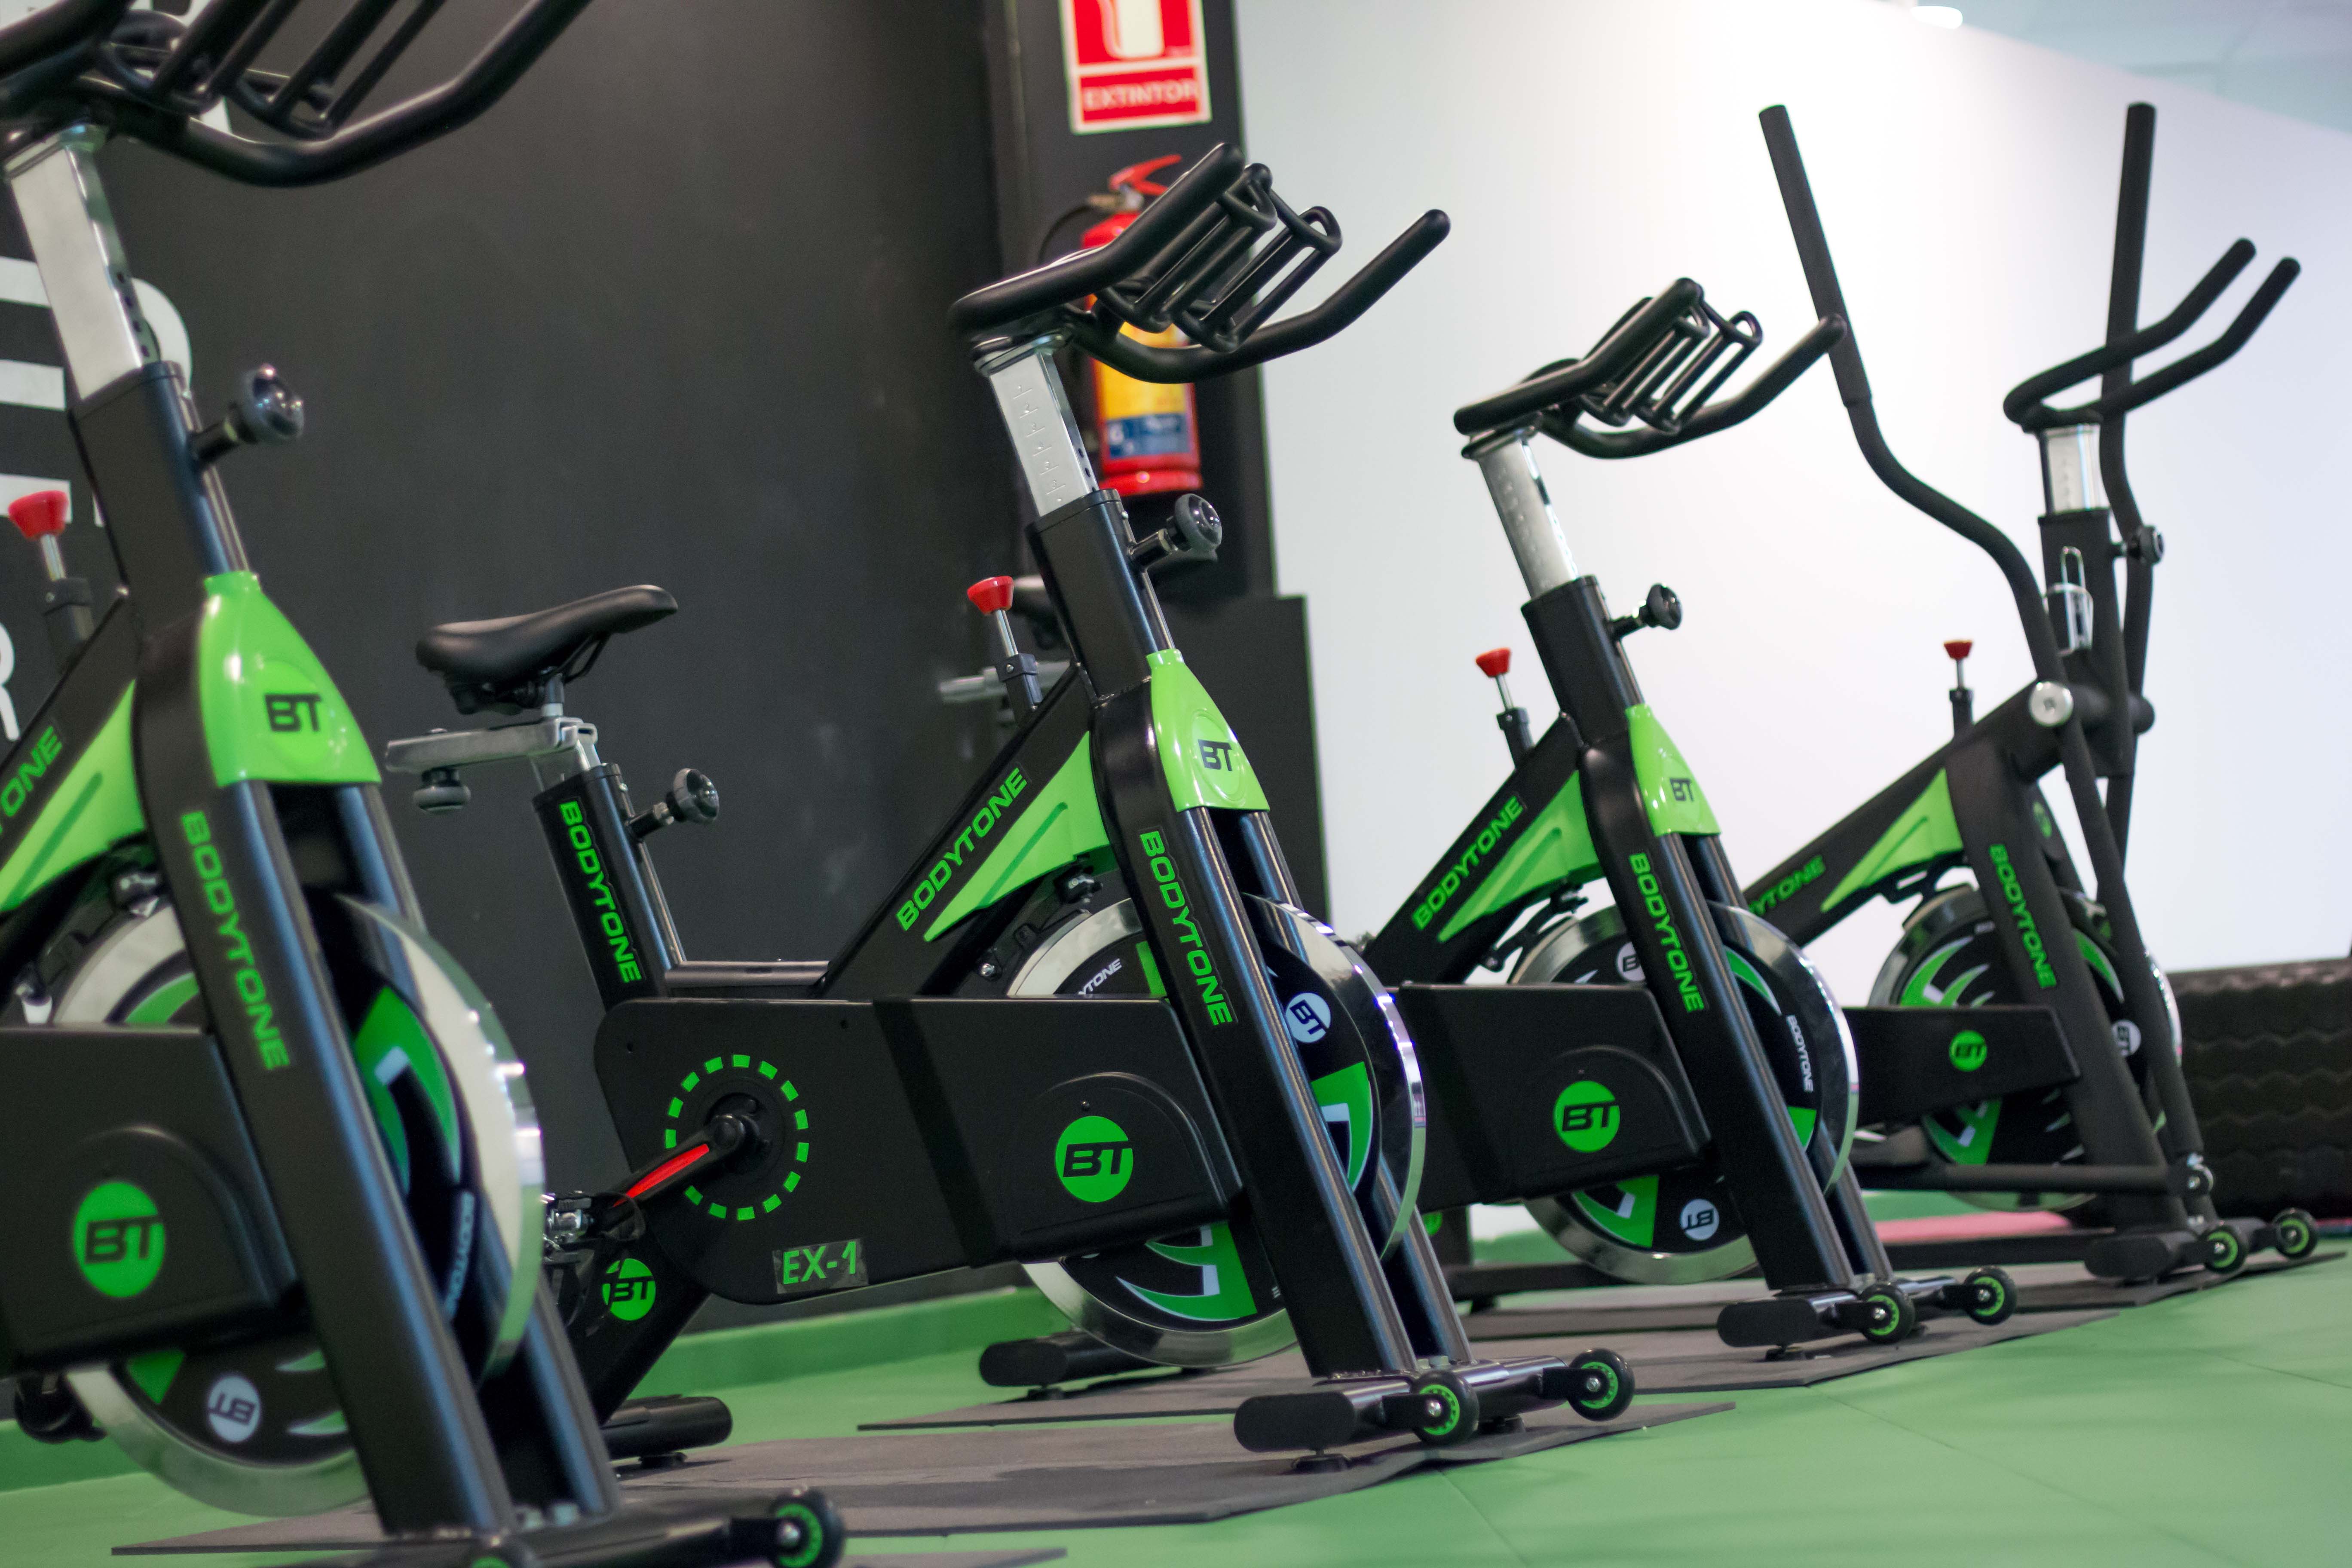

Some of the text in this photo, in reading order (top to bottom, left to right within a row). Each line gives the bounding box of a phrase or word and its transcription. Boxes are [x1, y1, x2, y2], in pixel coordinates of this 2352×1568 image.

[1084, 79, 1197, 107] EXTINTOR
[264, 693, 322, 732] BT
[1198, 739, 1232, 771] BT
[1670, 778, 1694, 802] BT
[896, 767, 1027, 931] BODYTONE
[1411, 796, 1525, 931] BODYTONE
[559, 800, 642, 983] BODYTONE
[1140, 830, 1233, 1026] BODYTONE
[1629, 852, 1704, 1013] BODYTONE
[1989, 844, 2056, 989] BODYTONE
[181, 810, 291, 1071] BODYTONE
[1623, 954, 1641, 972] B
[1290, 999, 1329, 1035] BT
[1786, 1014, 1813, 1093] BODYTONE
[1562, 1101, 1619, 1131] BT
[1063, 1140, 1133, 1178] BT
[84, 1215, 163, 1265] BT
[1683, 1209, 1714, 1231] BT
[782, 1241, 856, 1285] EX-1
[208, 1393, 256, 1426] BT
